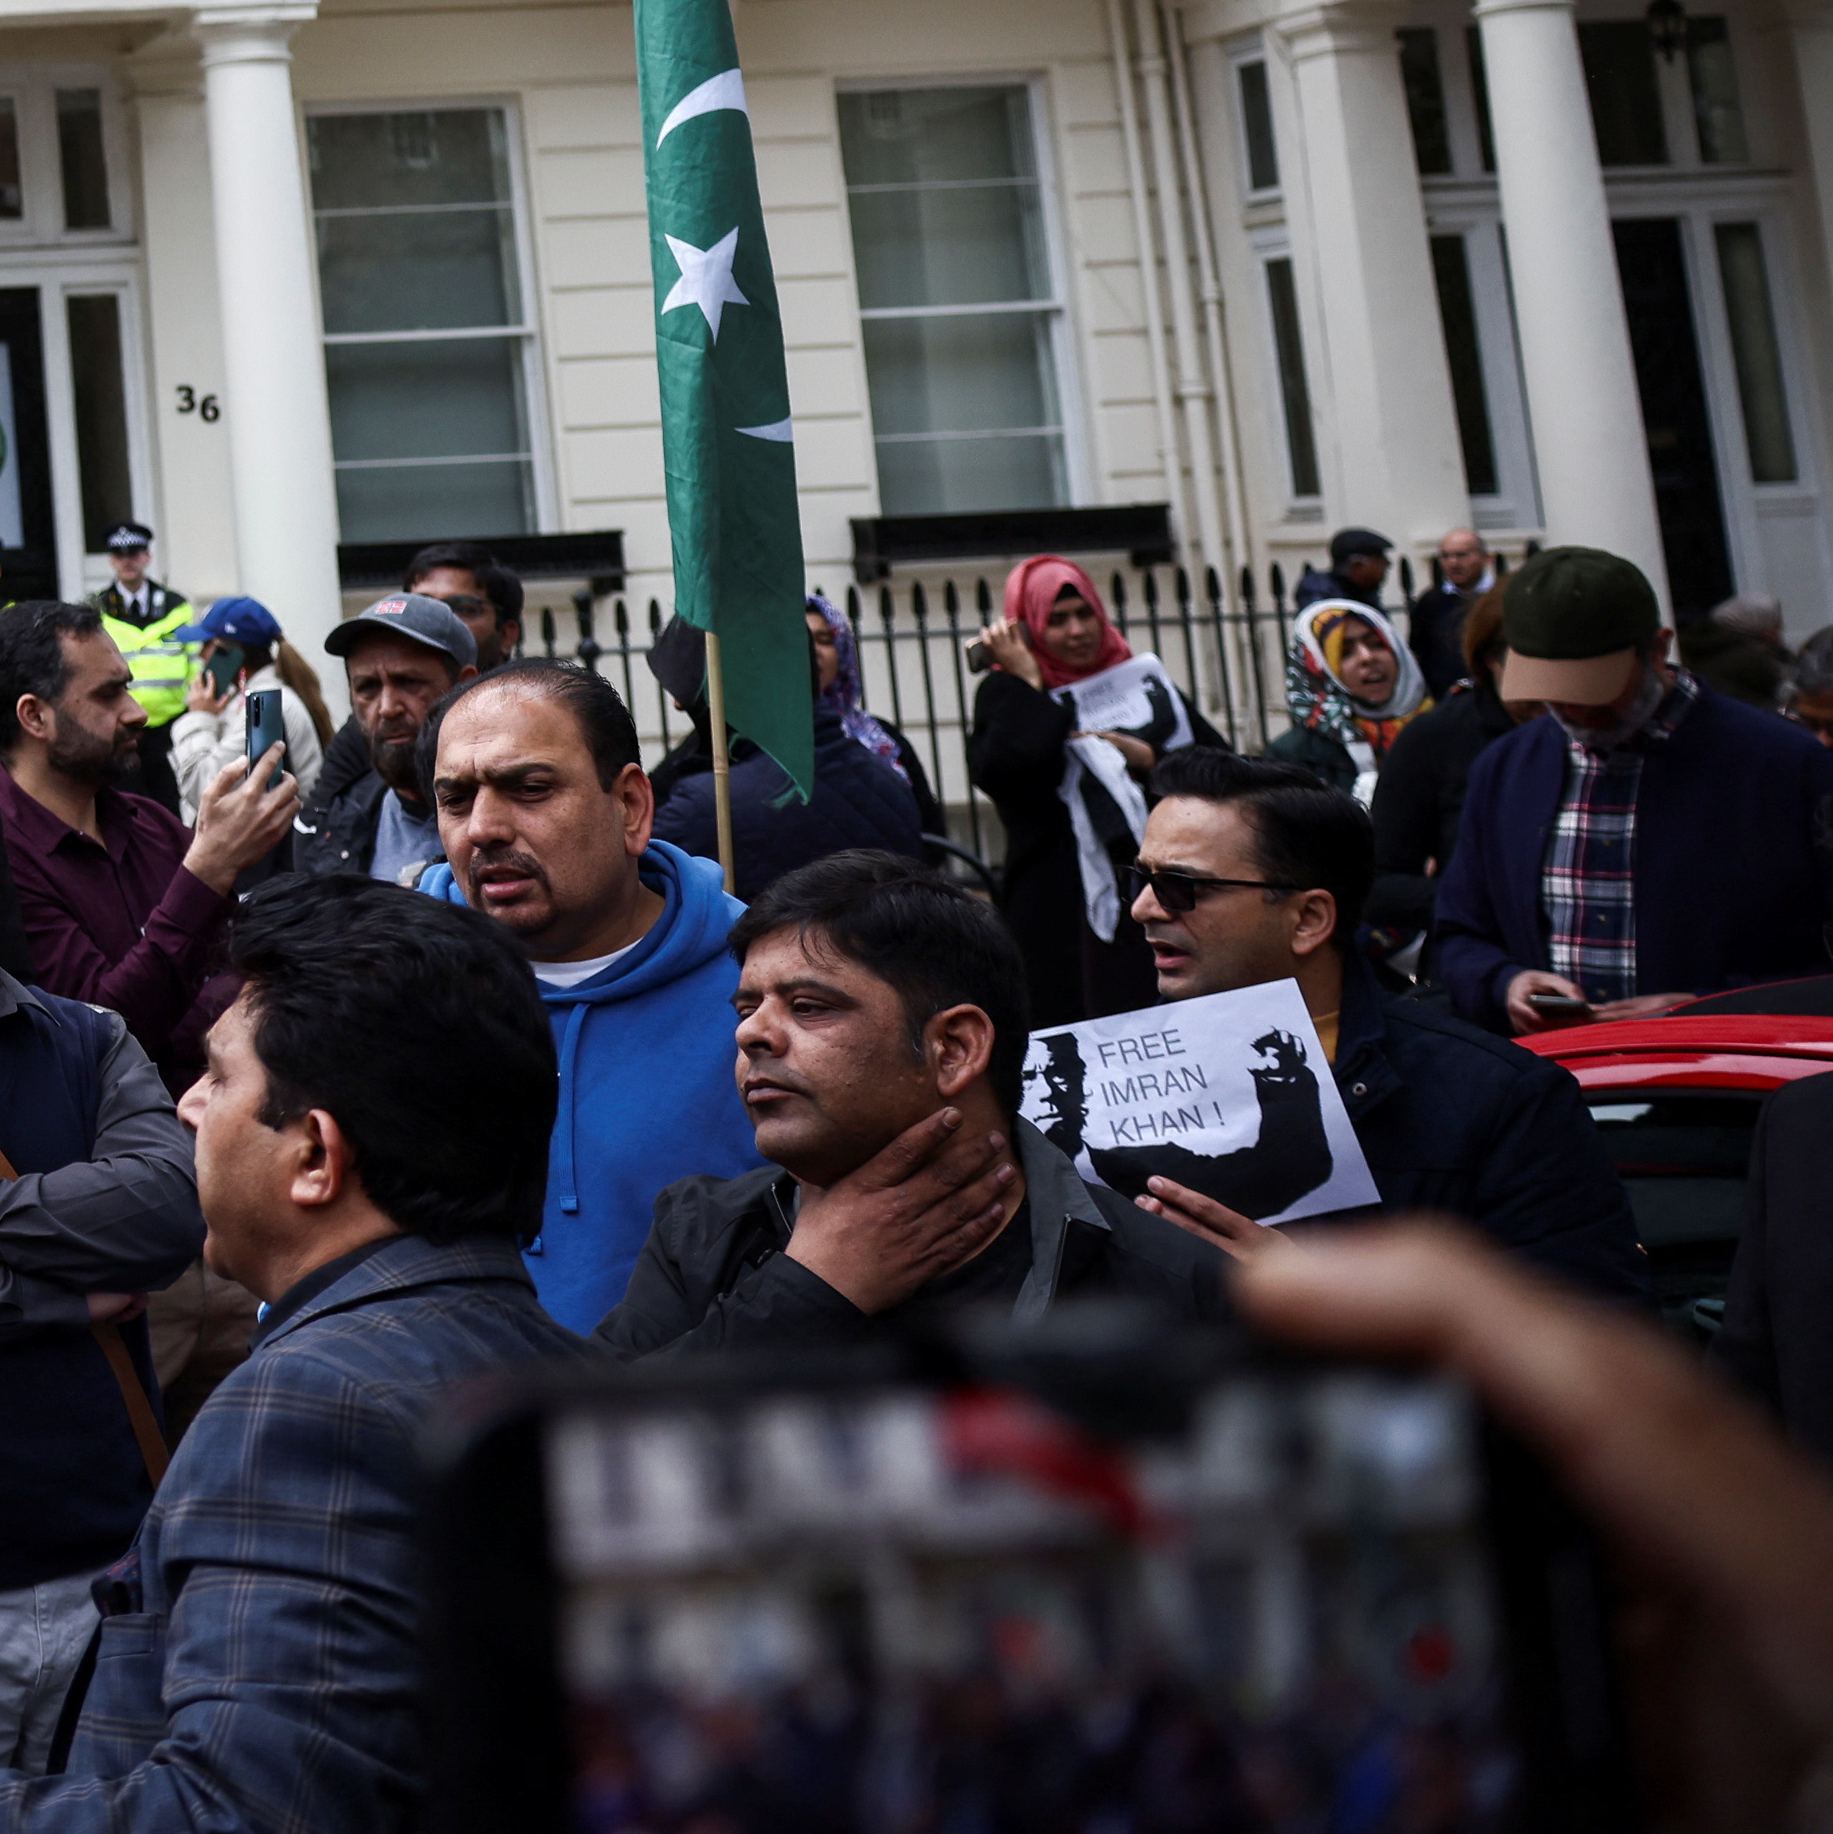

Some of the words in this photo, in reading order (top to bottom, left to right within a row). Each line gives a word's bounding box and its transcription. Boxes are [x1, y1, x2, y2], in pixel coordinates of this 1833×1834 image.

[175, 385, 221, 423] 36
[1097, 1028, 1187, 1069] FREE
[1100, 1064, 1208, 1108] IMRAN
[1110, 1113, 1207, 1146] KHAN
